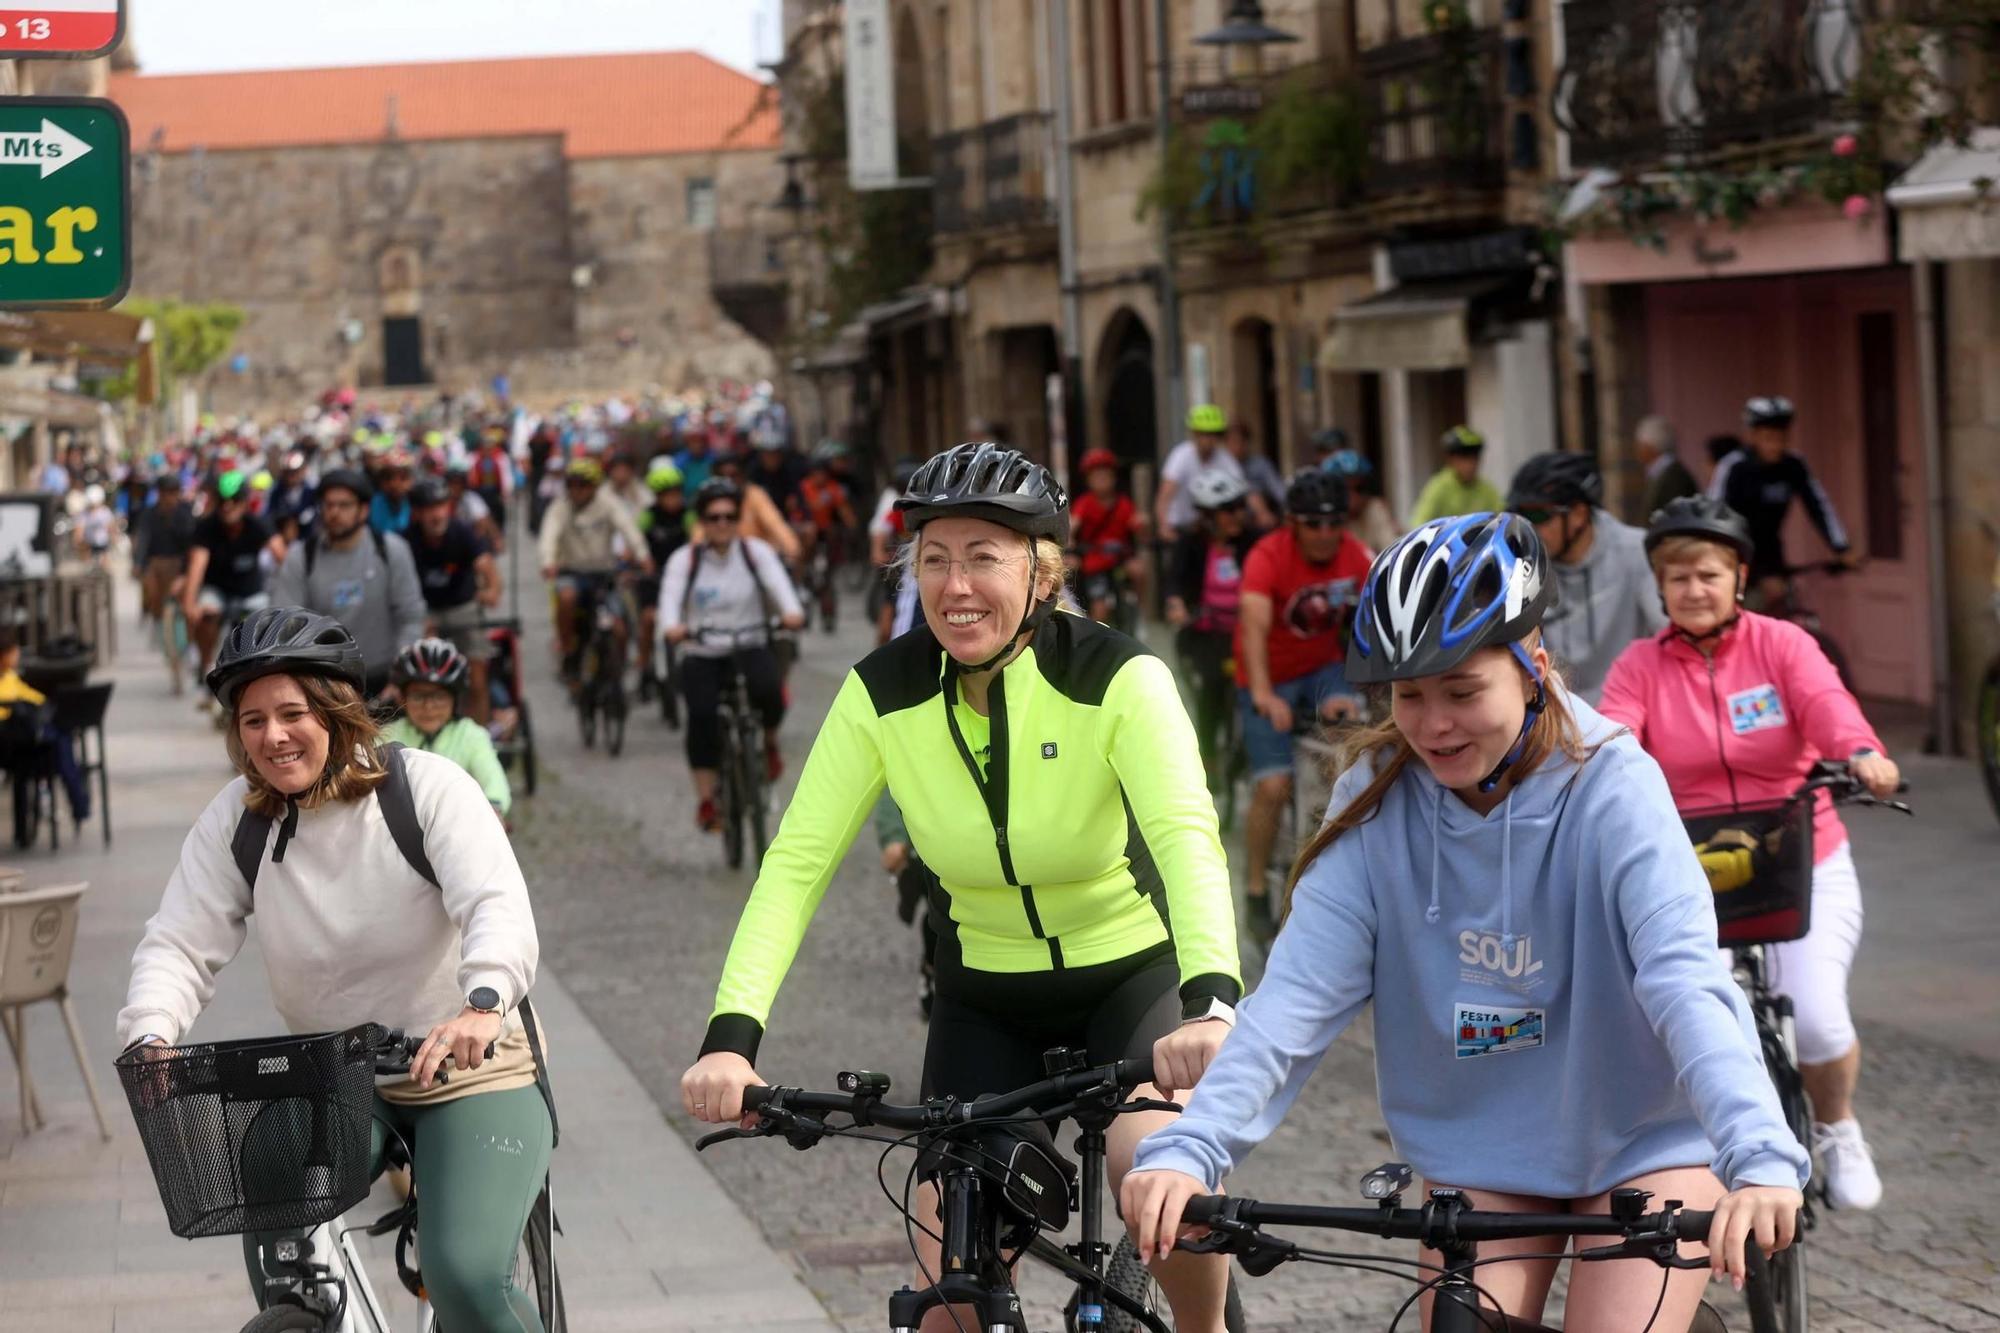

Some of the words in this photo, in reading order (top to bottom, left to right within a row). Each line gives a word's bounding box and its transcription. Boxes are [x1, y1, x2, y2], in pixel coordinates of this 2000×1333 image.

[15, 18, 51, 40] 13
[4, 138, 63, 158] Mts
[1459, 930, 1544, 977] SOUL
[1461, 1011, 1501, 1022] FESTA
